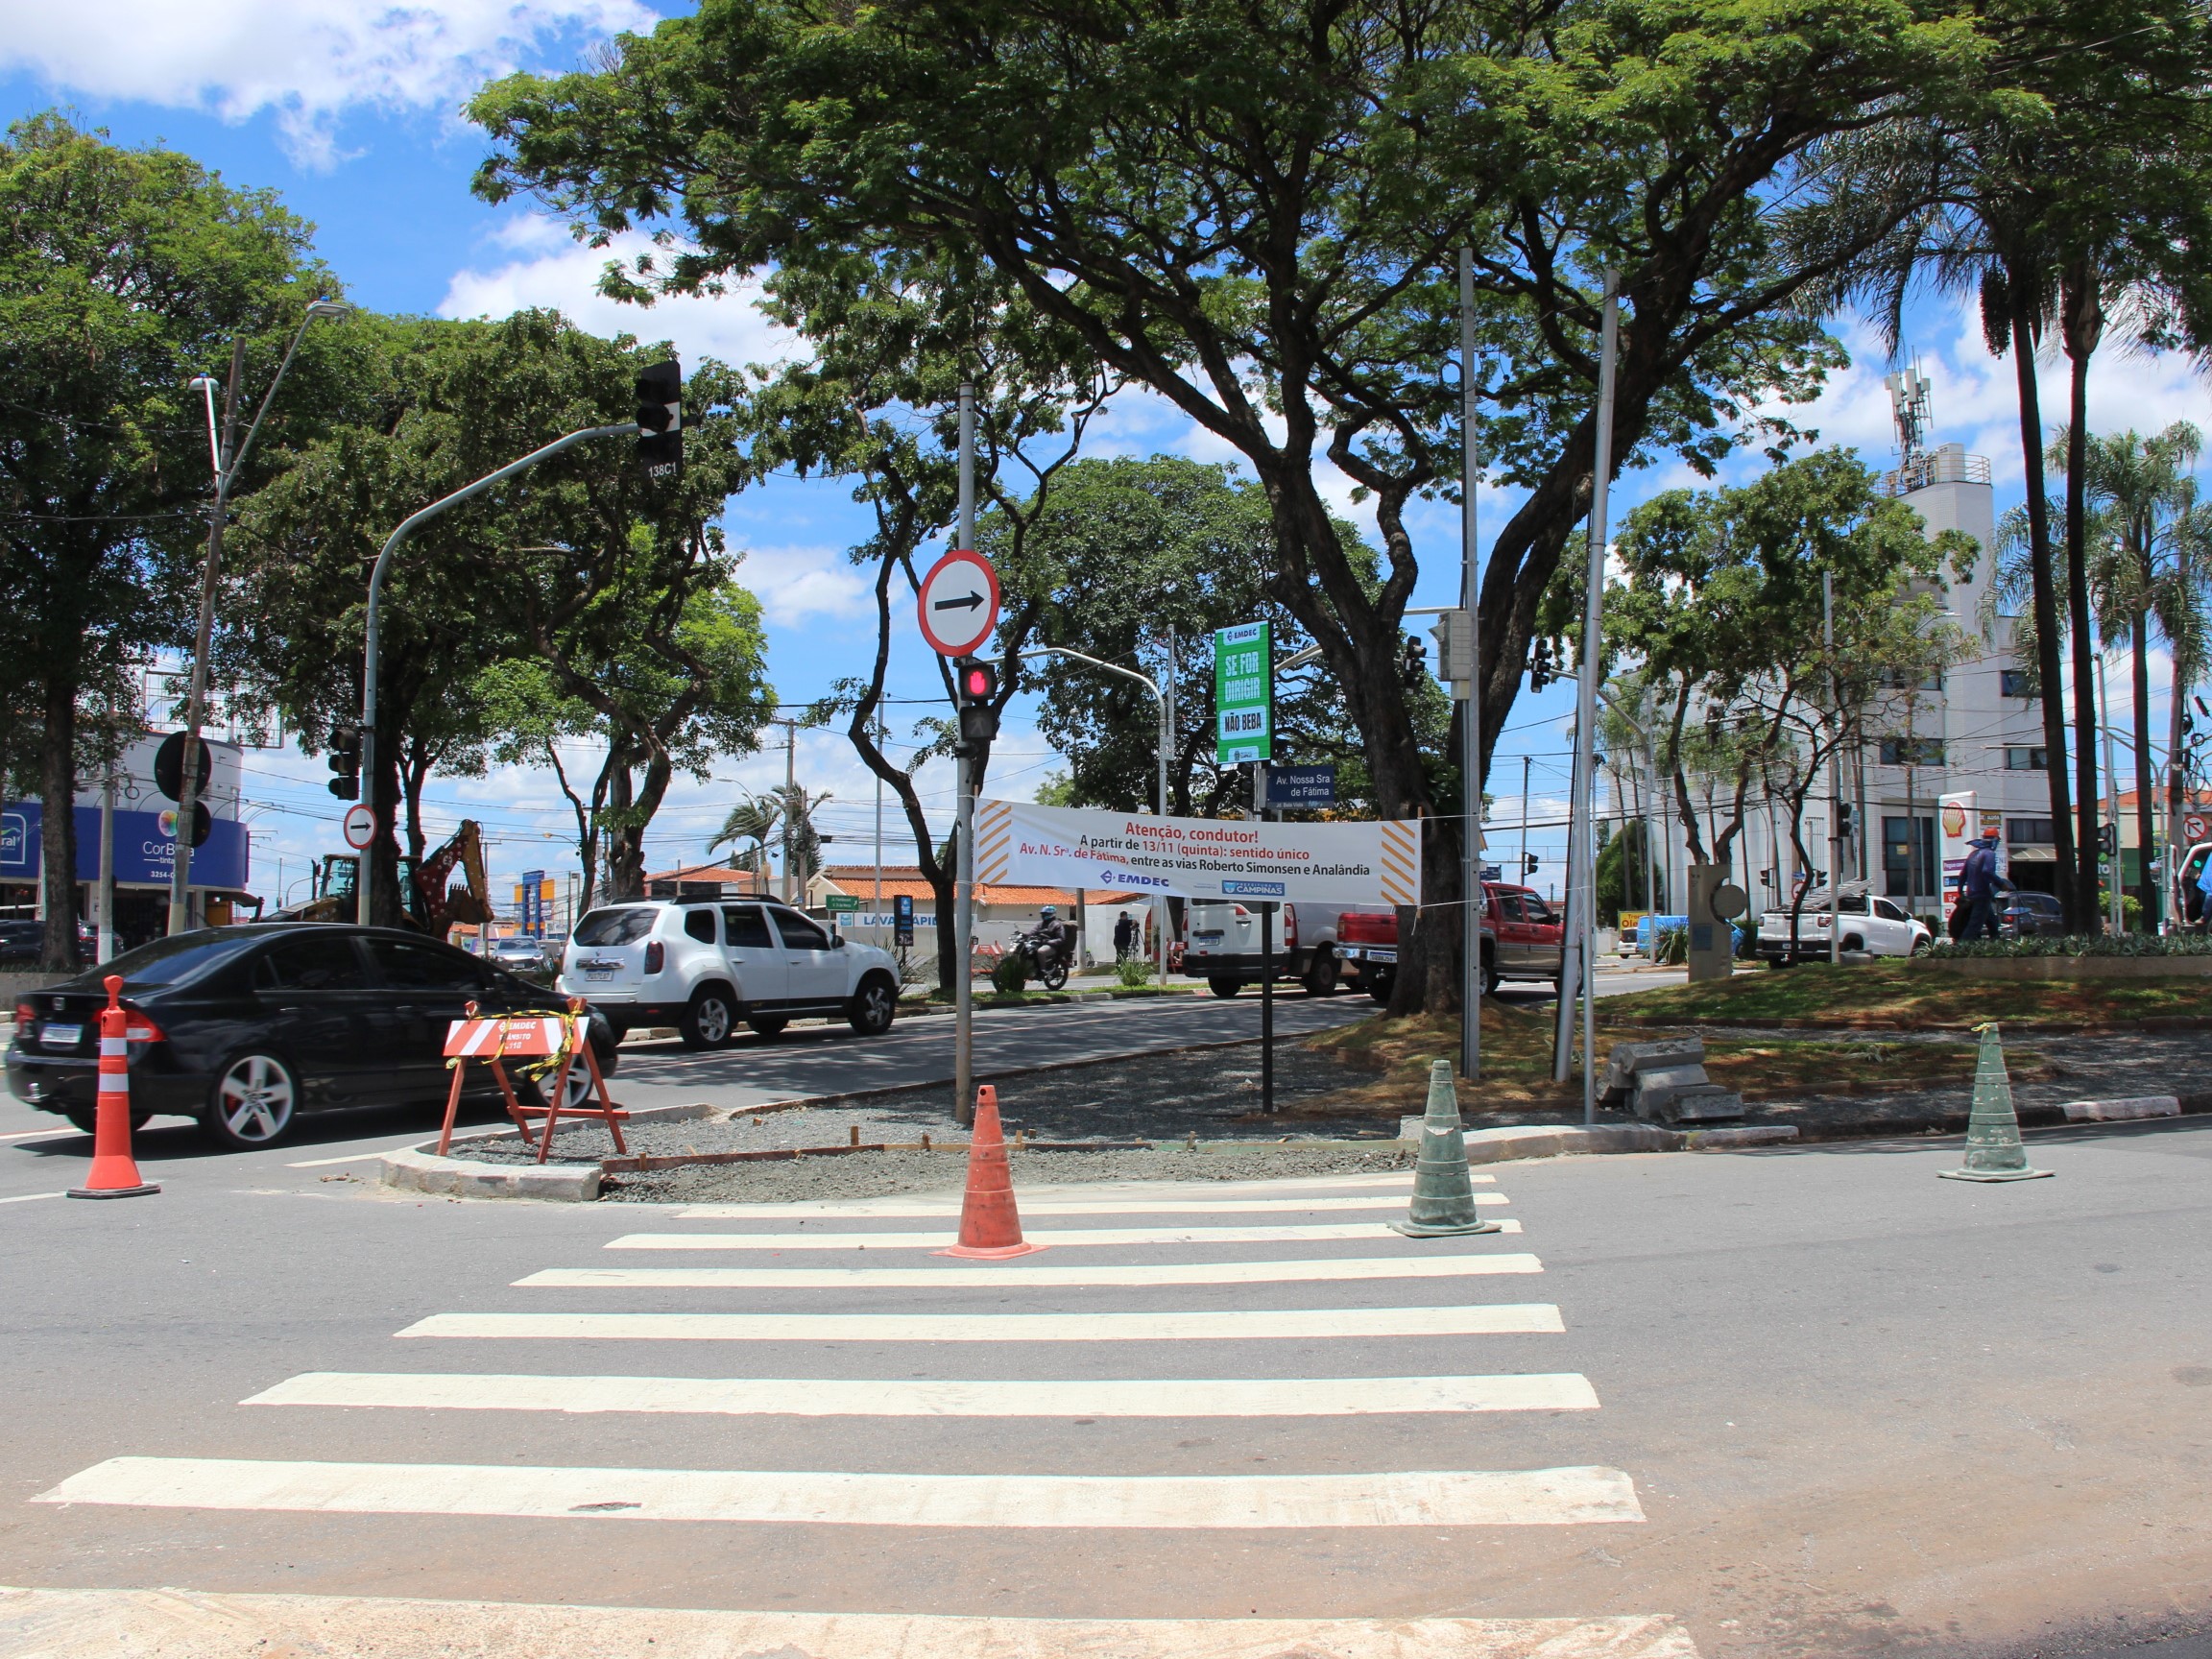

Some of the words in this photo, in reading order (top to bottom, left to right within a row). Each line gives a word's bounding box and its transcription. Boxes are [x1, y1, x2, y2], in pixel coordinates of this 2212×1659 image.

[1234, 628, 1257, 639] EMDEC
[1225, 654, 1238, 677] SE
[1239, 651, 1259, 675] FOR
[1225, 677, 1261, 703] DIRIGIR
[1224, 711, 1239, 733] NÃO
[1241, 712, 1262, 731] BEBA
[1276, 776, 1287, 785] Av.
[1289, 775, 1314, 784] Nossa
[1316, 774, 1331, 783] Sra
[1290, 787, 1301, 797] de
[1302, 786, 1330, 796] Fátima
[1125, 821, 1186, 841] Atenção,
[1189, 828, 1259, 844] condutor!
[143, 841, 194, 857] CorBa
[1080, 834, 1088, 846] A
[1091, 837, 1122, 850] partir
[1125, 838, 1140, 851] de
[1142, 840, 1173, 854] 13/11
[1177, 842, 1227, 858] (quinta):
[1229, 848, 1274, 859] sentido
[1277, 848, 1310, 860] único
[159, 855, 177, 865] tinta
[1020, 842, 1037, 854] Av.
[1040, 844, 1051, 855] N.
[1074, 848, 1088, 859] de
[1091, 849, 1129, 865] Fátima,
[1131, 856, 1160, 868] entre
[1162, 858, 1173, 868] as
[1175, 858, 1197, 870] vias
[1199, 859, 1244, 873] Roberto
[1246, 861, 1301, 875] Simonsen
[1303, 866, 1310, 875] e
[1312, 864, 1370, 876] Analândia
[1118, 874, 1169, 887] EMDEC
[1236, 885, 1283, 895] CAMPINAS
[498, 1032, 532, 1042] TÂNSITO
